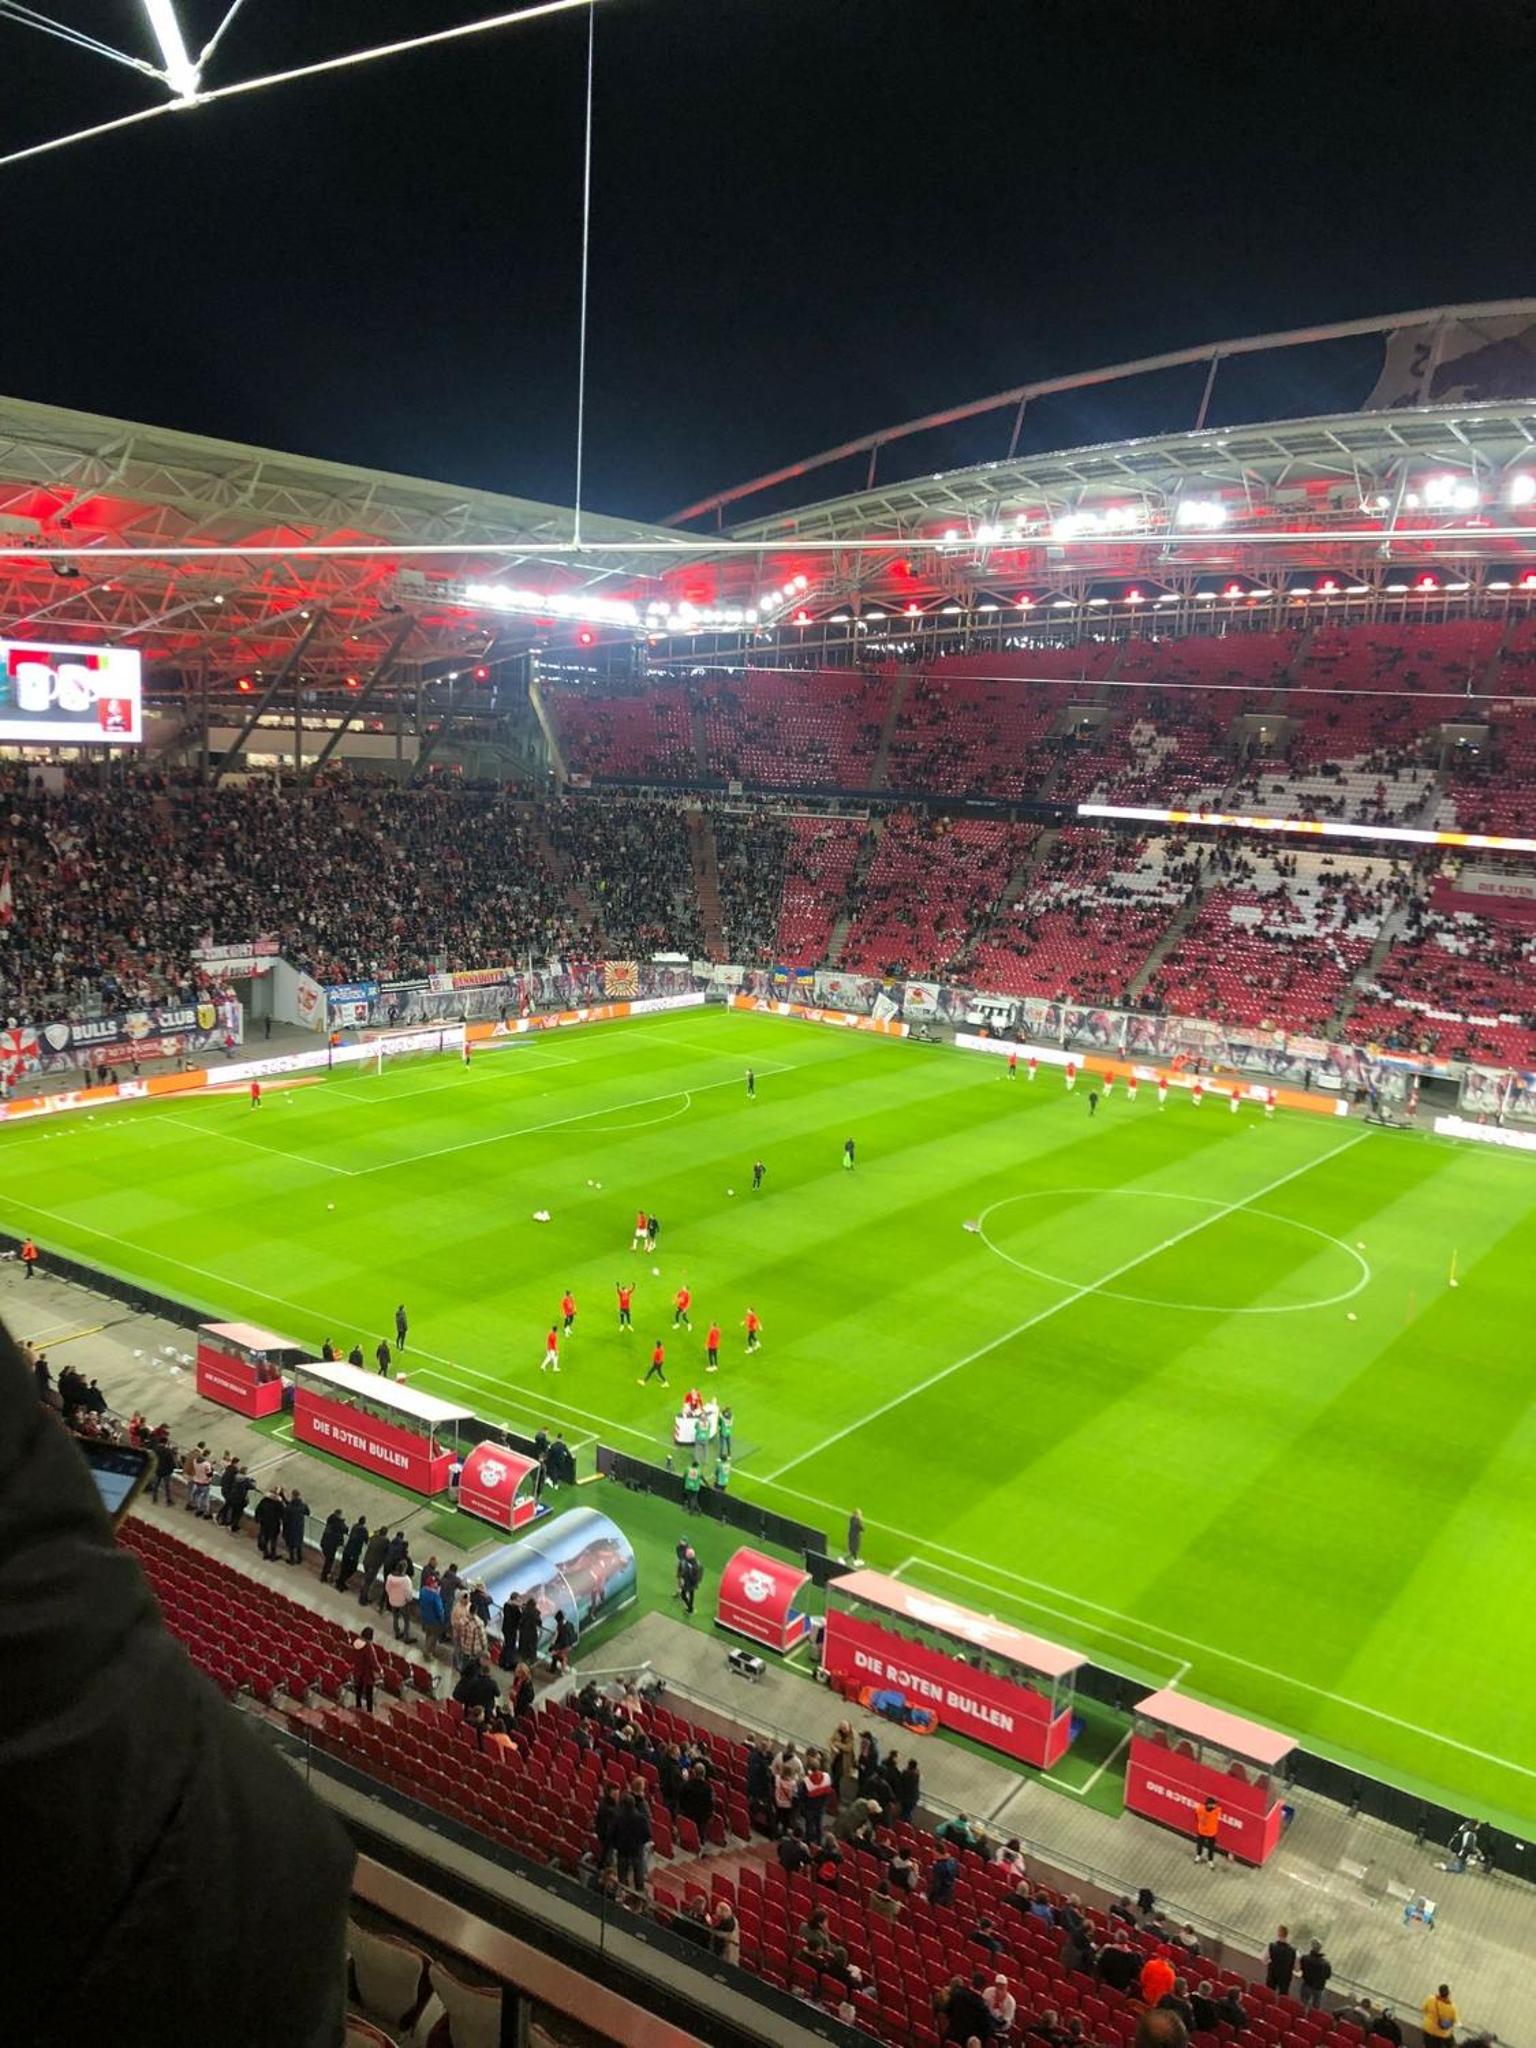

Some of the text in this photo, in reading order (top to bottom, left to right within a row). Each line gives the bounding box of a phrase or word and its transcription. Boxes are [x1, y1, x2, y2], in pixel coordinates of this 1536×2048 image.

[72, 1020, 118, 1040] BULLS
[159, 1010, 196, 1028] CLUB
[313, 1419, 409, 1469] DIE ROTEN BULLEN
[854, 1650, 1014, 1732] DIE ROTEN BULLEN
[1146, 1780, 1165, 1796] DIE
